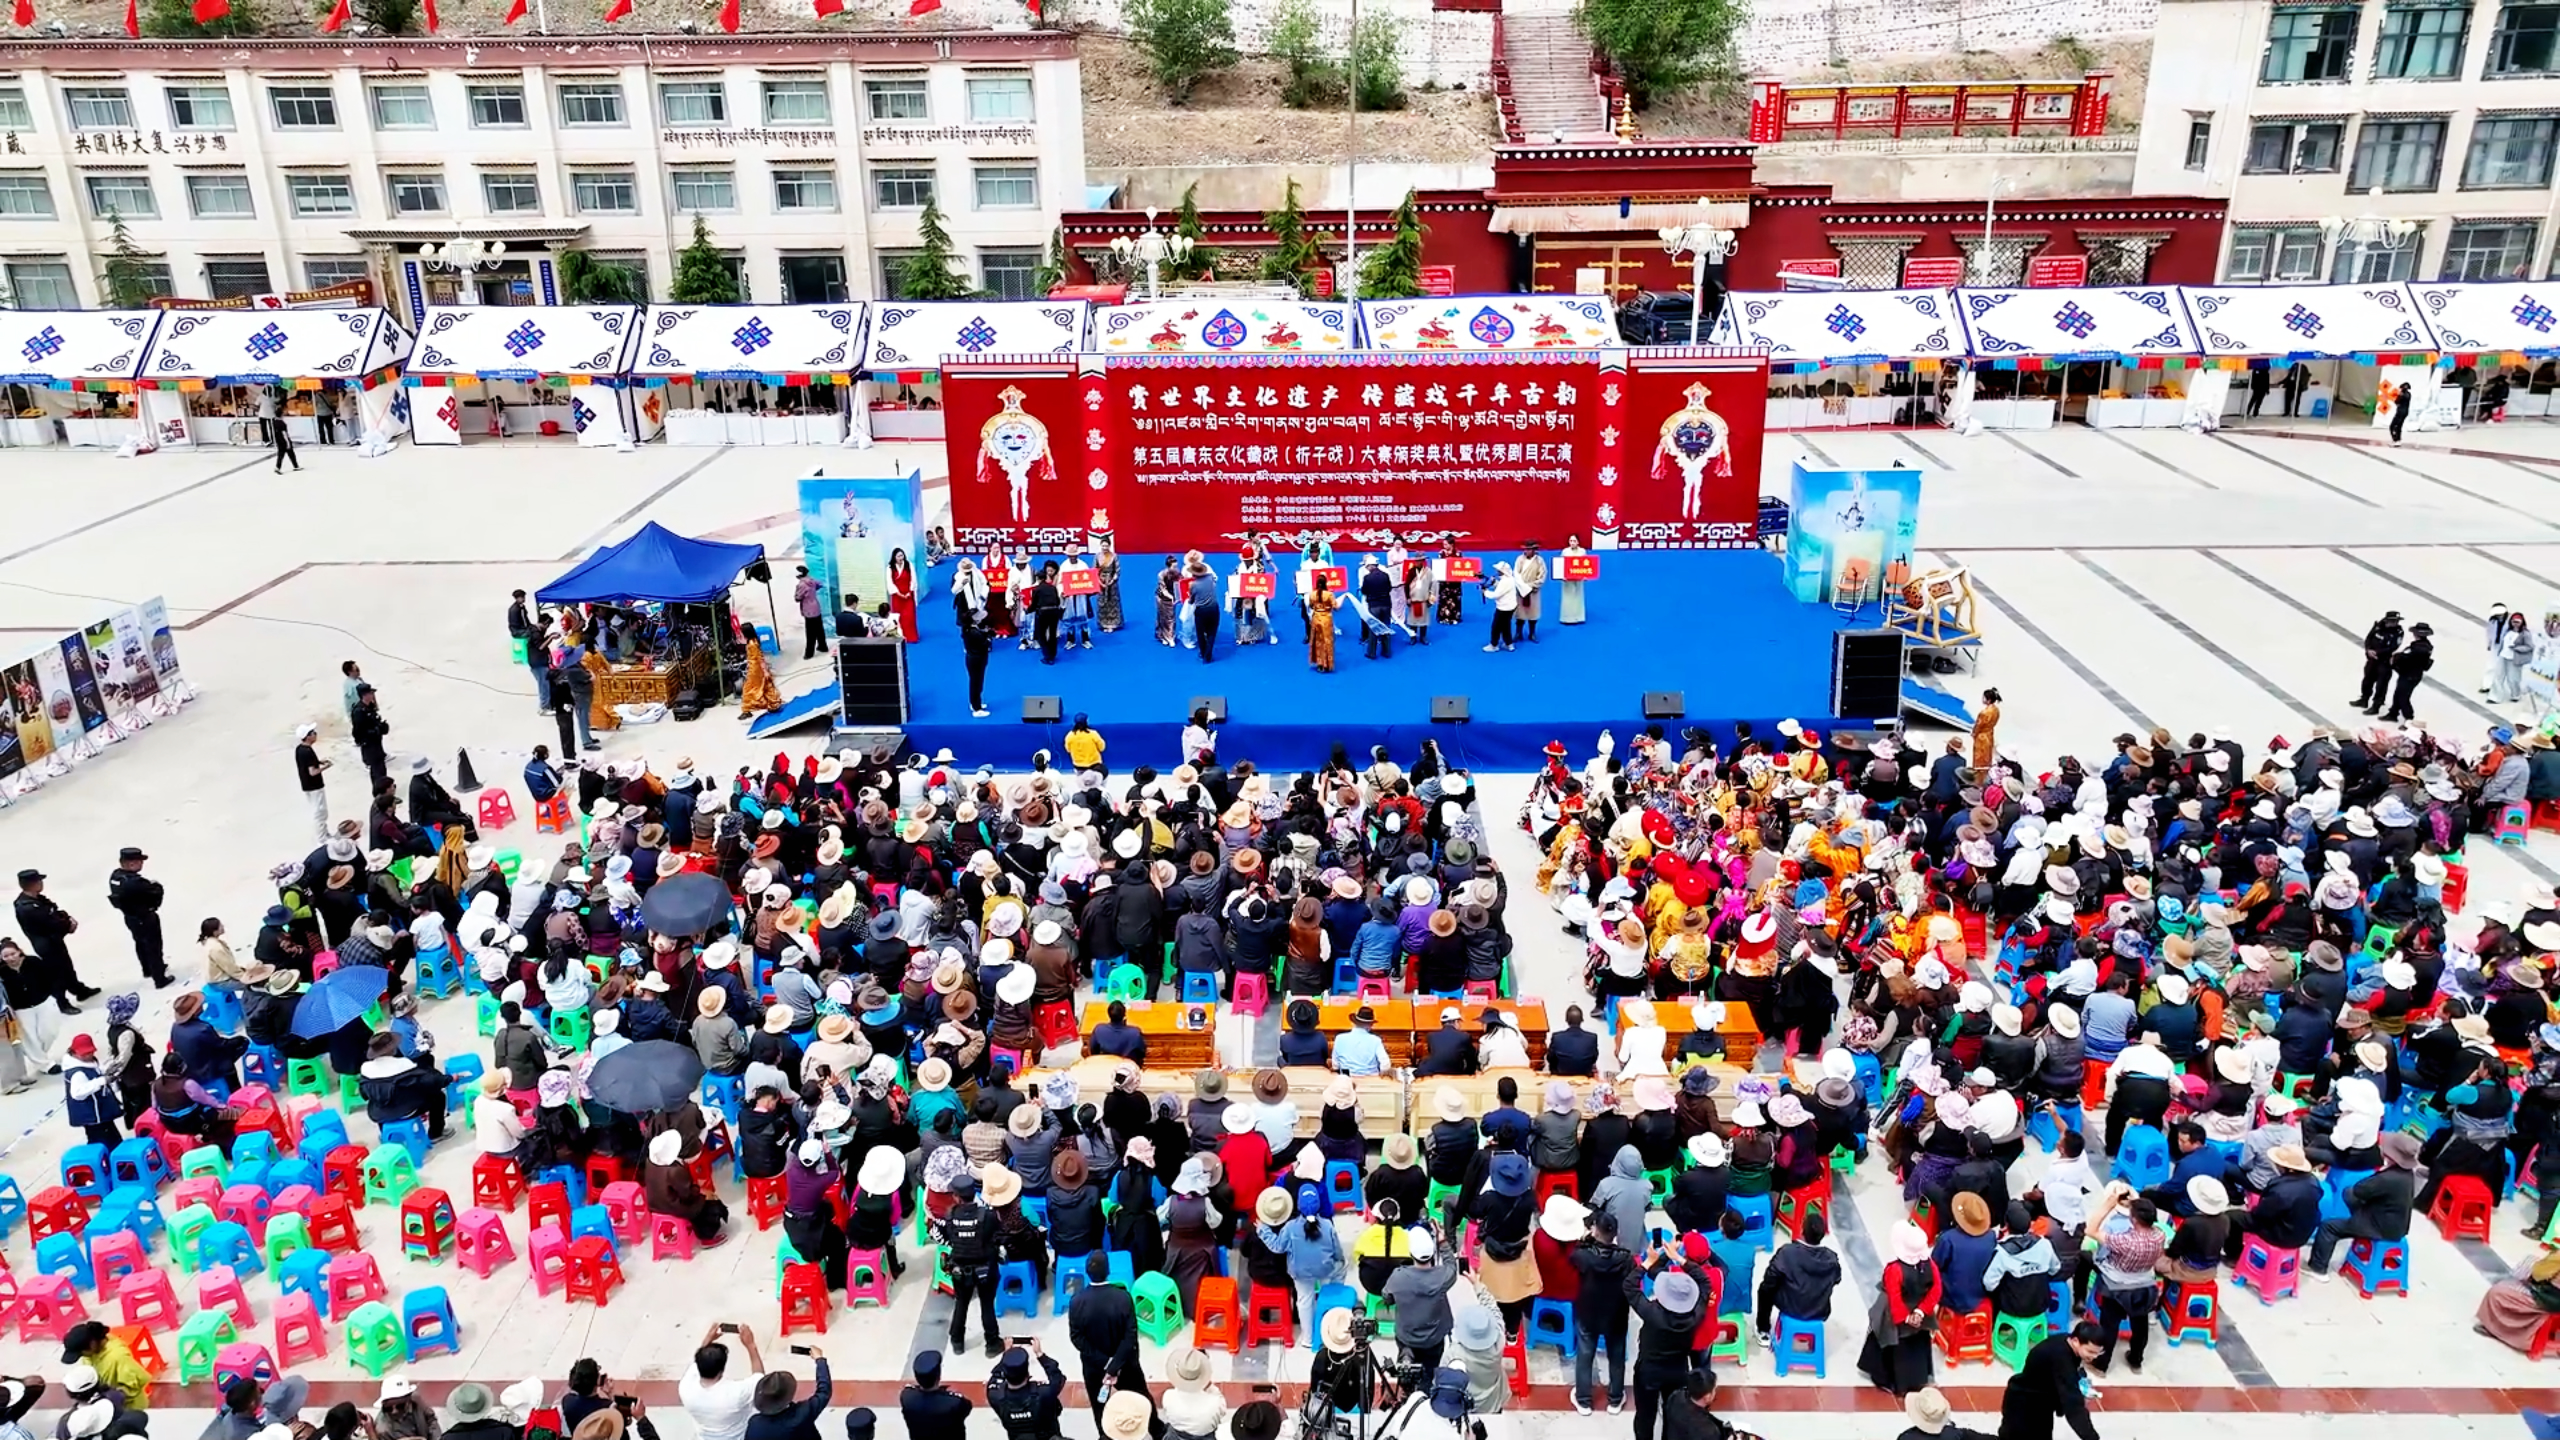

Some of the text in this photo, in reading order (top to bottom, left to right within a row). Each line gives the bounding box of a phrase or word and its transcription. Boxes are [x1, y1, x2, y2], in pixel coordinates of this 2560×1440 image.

[0, 131, 26, 155] 藏
[1128, 381, 1577, 411] 赏世界文化遗产 传藏戏千年古韵
